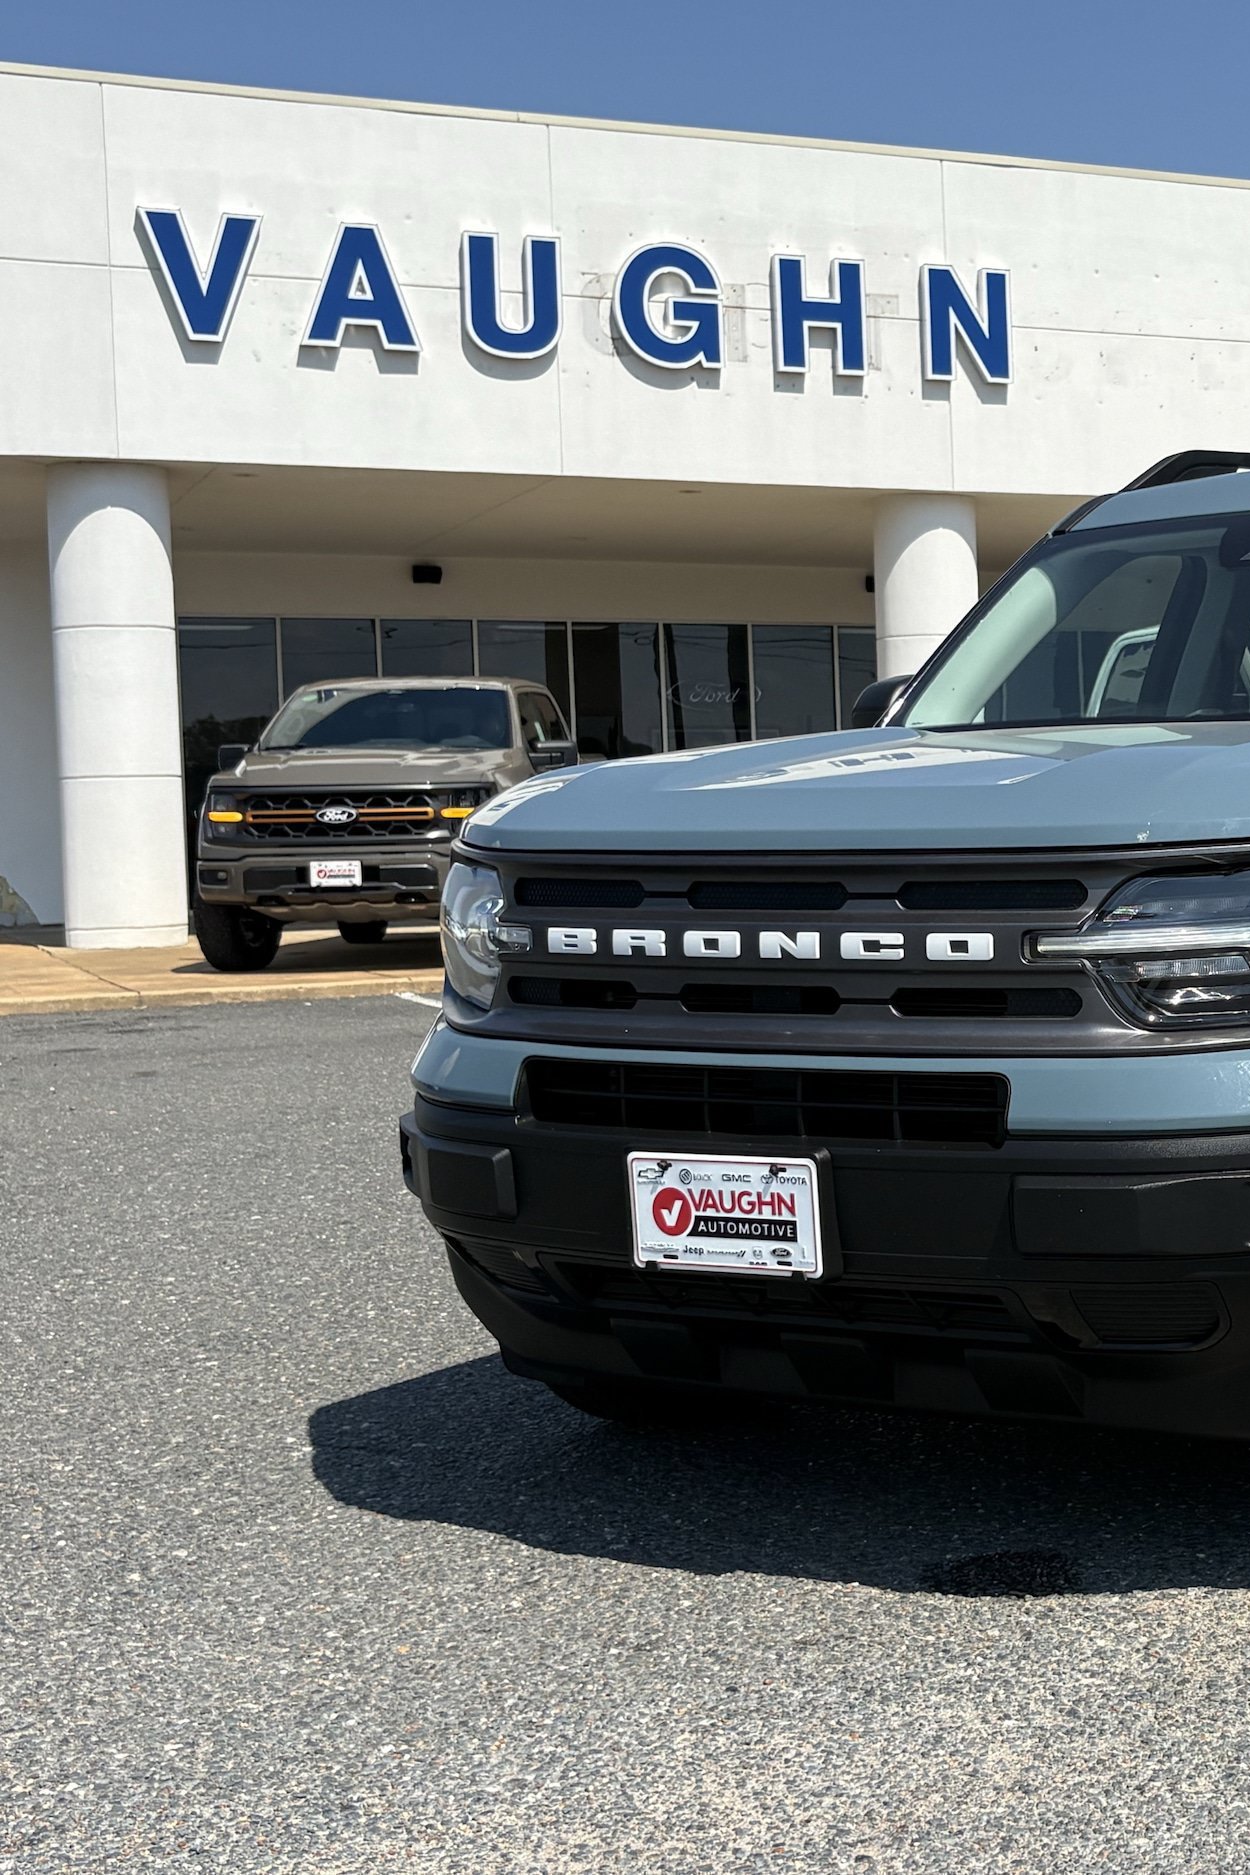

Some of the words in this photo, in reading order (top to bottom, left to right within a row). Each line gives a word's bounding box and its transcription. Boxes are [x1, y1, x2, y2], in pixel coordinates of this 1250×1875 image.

[137, 207, 1012, 384] VAUGHN
[690, 681, 740, 703] Ford
[547, 927, 995, 960] BRONCO
[721, 1173, 752, 1183] GMC
[776, 1176, 808, 1186] TOYOTA
[687, 1188, 797, 1217] VAUGHN
[698, 1220, 795, 1237] AUTOMOTIVE
[683, 1244, 705, 1256] Jeep
